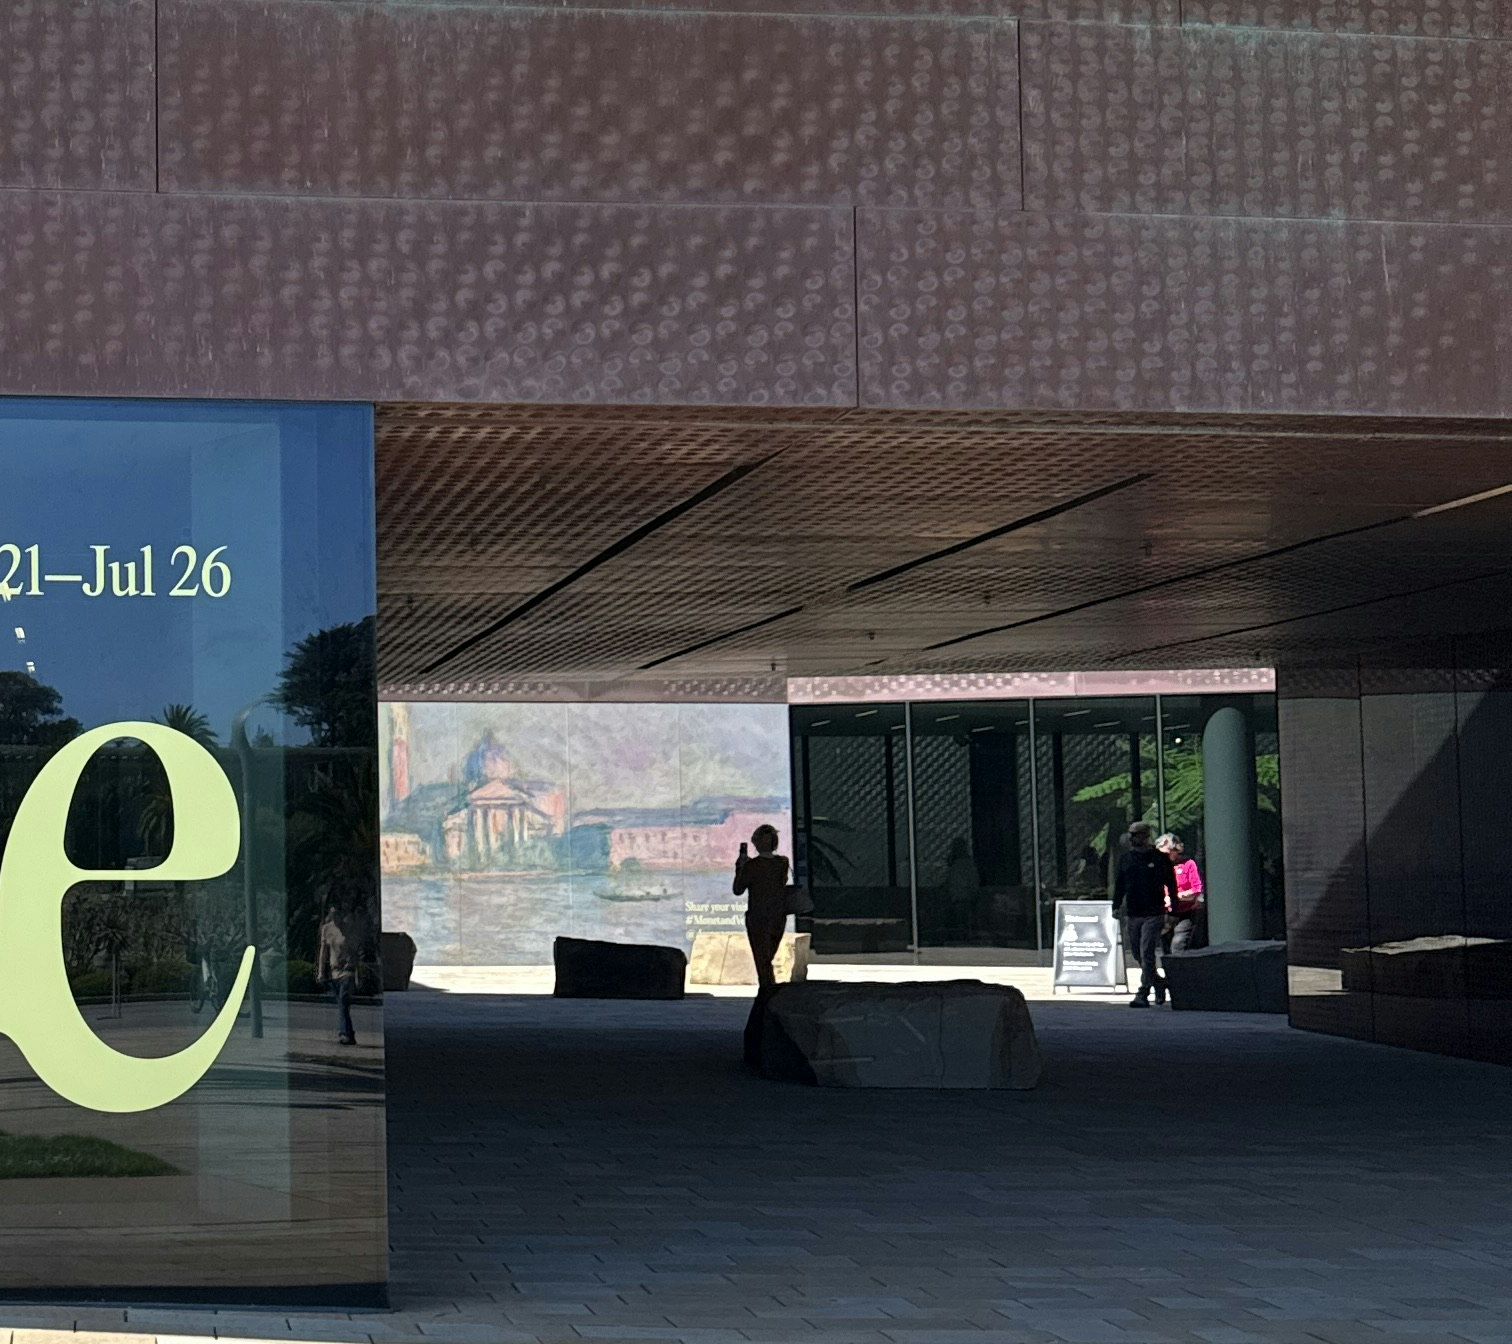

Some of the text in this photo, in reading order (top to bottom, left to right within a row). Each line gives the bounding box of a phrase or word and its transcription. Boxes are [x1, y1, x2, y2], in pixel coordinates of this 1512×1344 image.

[169, 545, 232, 598] 26
[685, 901, 710, 913] Share
[711, 903, 729, 915] your
